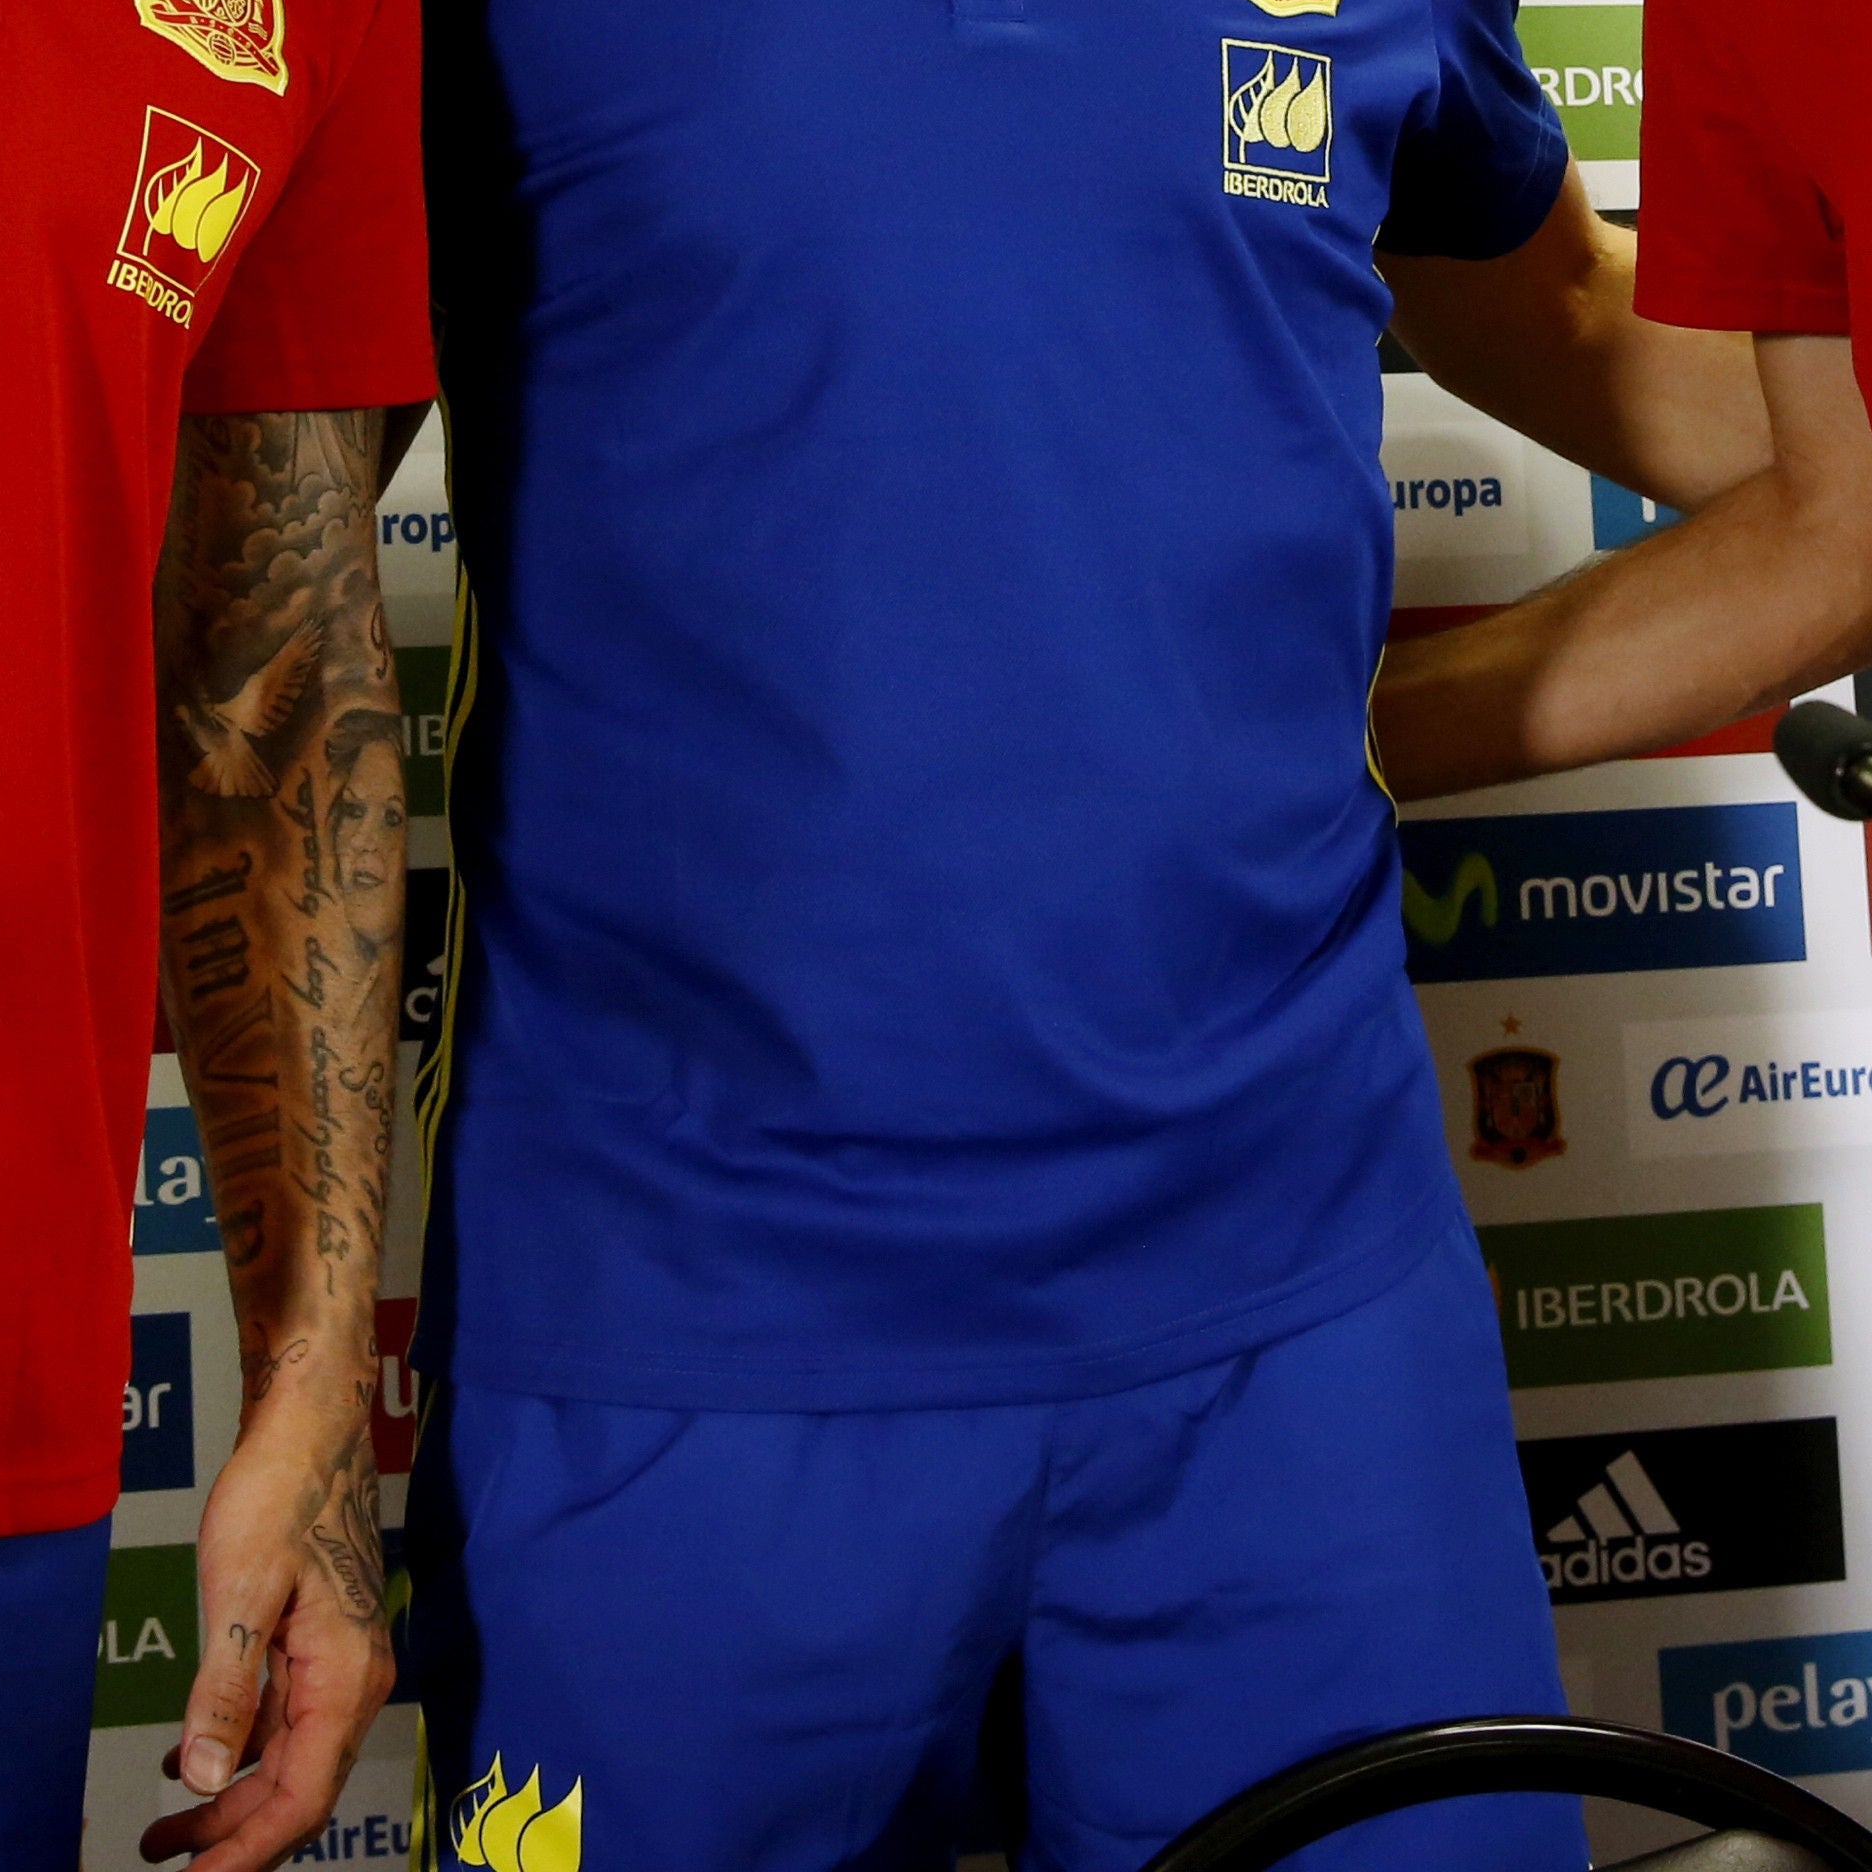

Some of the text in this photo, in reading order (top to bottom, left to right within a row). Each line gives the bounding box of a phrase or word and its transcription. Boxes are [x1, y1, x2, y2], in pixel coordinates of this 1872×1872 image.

[1224, 170, 1329, 208] IBERDROLA
[1520, 861, 1784, 921] movistar
[1517, 1268, 1809, 1330] IBERDROLA
